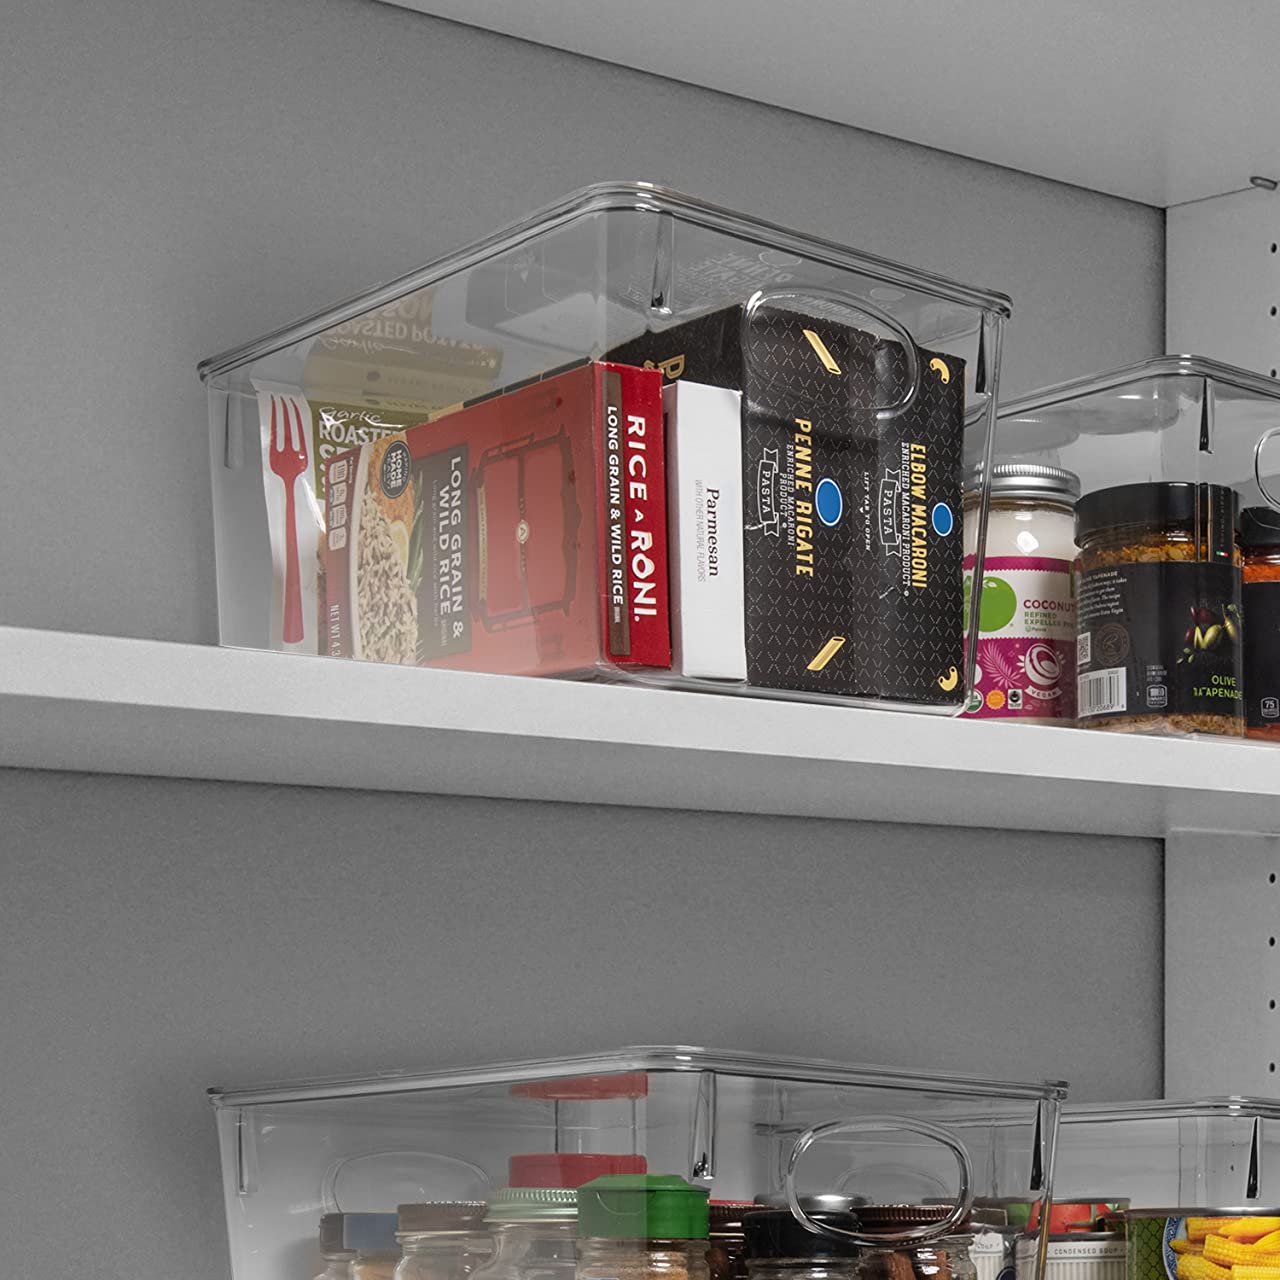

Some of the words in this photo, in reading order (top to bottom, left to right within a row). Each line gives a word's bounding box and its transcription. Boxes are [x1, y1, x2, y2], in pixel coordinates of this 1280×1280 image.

[607, 406, 618, 449] LONG
[608, 454, 620, 504] GRAIN
[627, 415, 647, 500] RICE
[786, 444, 795, 493] ENRICHED
[795, 418, 813, 493] PENNE
[901, 441, 910, 490] ENRICHED
[910, 443, 928, 500] ELBOW
[450, 456, 462, 526] LONG
[610, 508, 621, 520] &
[635, 509, 645, 522] A
[761, 470, 772, 514] PASTA
[780, 473, 788, 517] PRODUCT
[883, 490, 894, 535] PASTA
[439, 485, 450, 551] WILD
[706, 487, 720, 577] Parmesan
[786, 496, 796, 547] MACARONI
[796, 500, 814, 578] RIGATE
[901, 492, 911, 541] MACARONI
[610, 524, 622, 565] WILD
[902, 543, 911, 587] PRODUCT
[911, 504, 928, 588] MACARONI
[440, 560, 451, 616] RICE
[450, 534, 464, 613] GRAIN
[612, 569, 624, 604] RICE
[452, 620, 464, 639] &
[1031, 689, 1058, 697] VEGAN
[1211, 674, 1237, 687] OLIVE
[1265, 701, 1275, 709] 75
